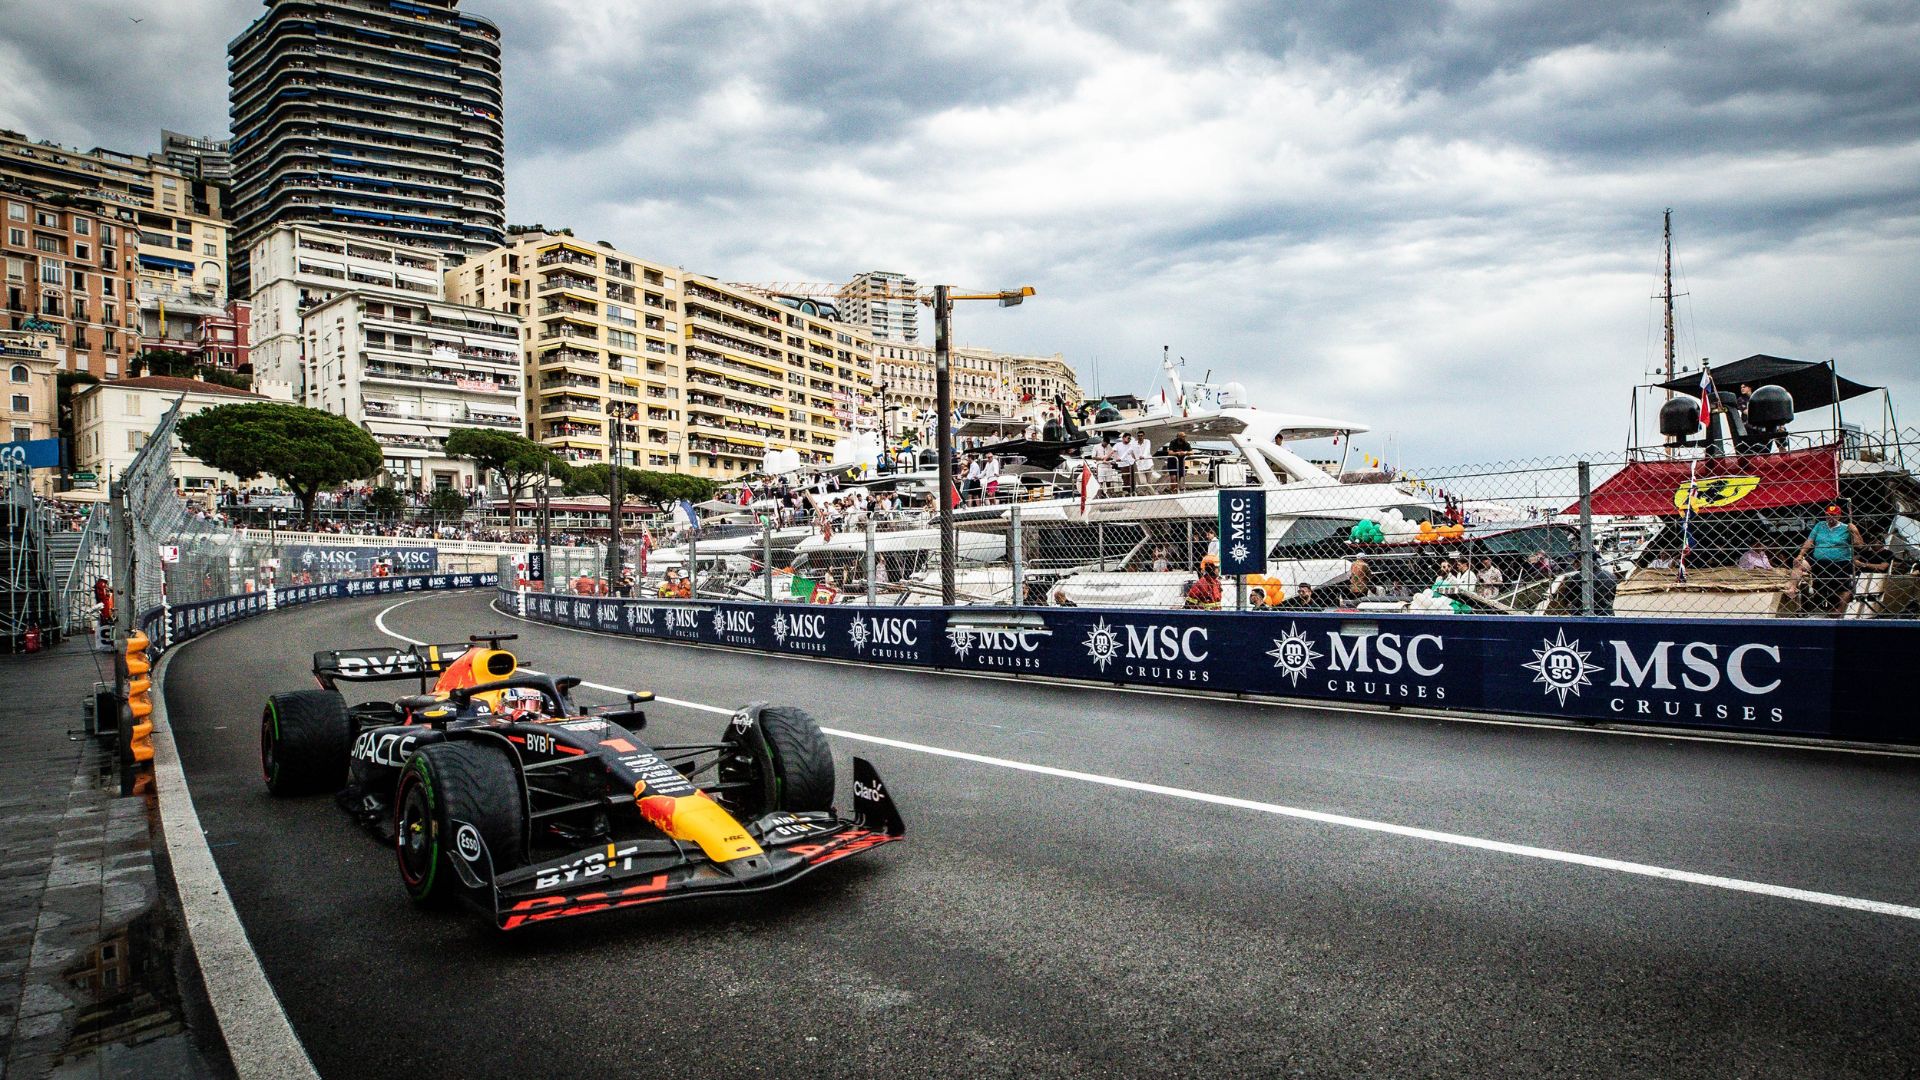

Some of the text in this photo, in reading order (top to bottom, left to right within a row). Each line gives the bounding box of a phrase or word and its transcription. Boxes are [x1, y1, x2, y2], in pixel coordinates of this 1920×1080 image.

[1231, 498, 1244, 540] MSC
[320, 551, 357, 563] MSC
[397, 551, 430, 563] MSC
[579, 603, 591, 619] MSC
[604, 605, 618, 622] MSC
[636, 606, 655, 625] MSC
[676, 608, 699, 628] MSC
[727, 610, 755, 632] MSC
[790, 613, 825, 639] MSC
[871, 617, 918, 646] MSC
[727, 635, 756, 645] CRUISES
[790, 641, 826, 651] CRUISES
[978, 630, 1039, 652] MSC
[1125, 624, 1209, 663] MSC
[872, 648, 919, 660] CRUISES
[978, 655, 1040, 668] CRUISES
[1326, 630, 1444, 677] MSC
[1126, 665, 1209, 682] CRUISES
[1609, 639, 1782, 695] MSC
[1328, 679, 1445, 699] CRUISES
[1610, 698, 1783, 722] CRUISES
[526, 733, 556, 755] BYBIT
[854, 780, 881, 802] Claro
